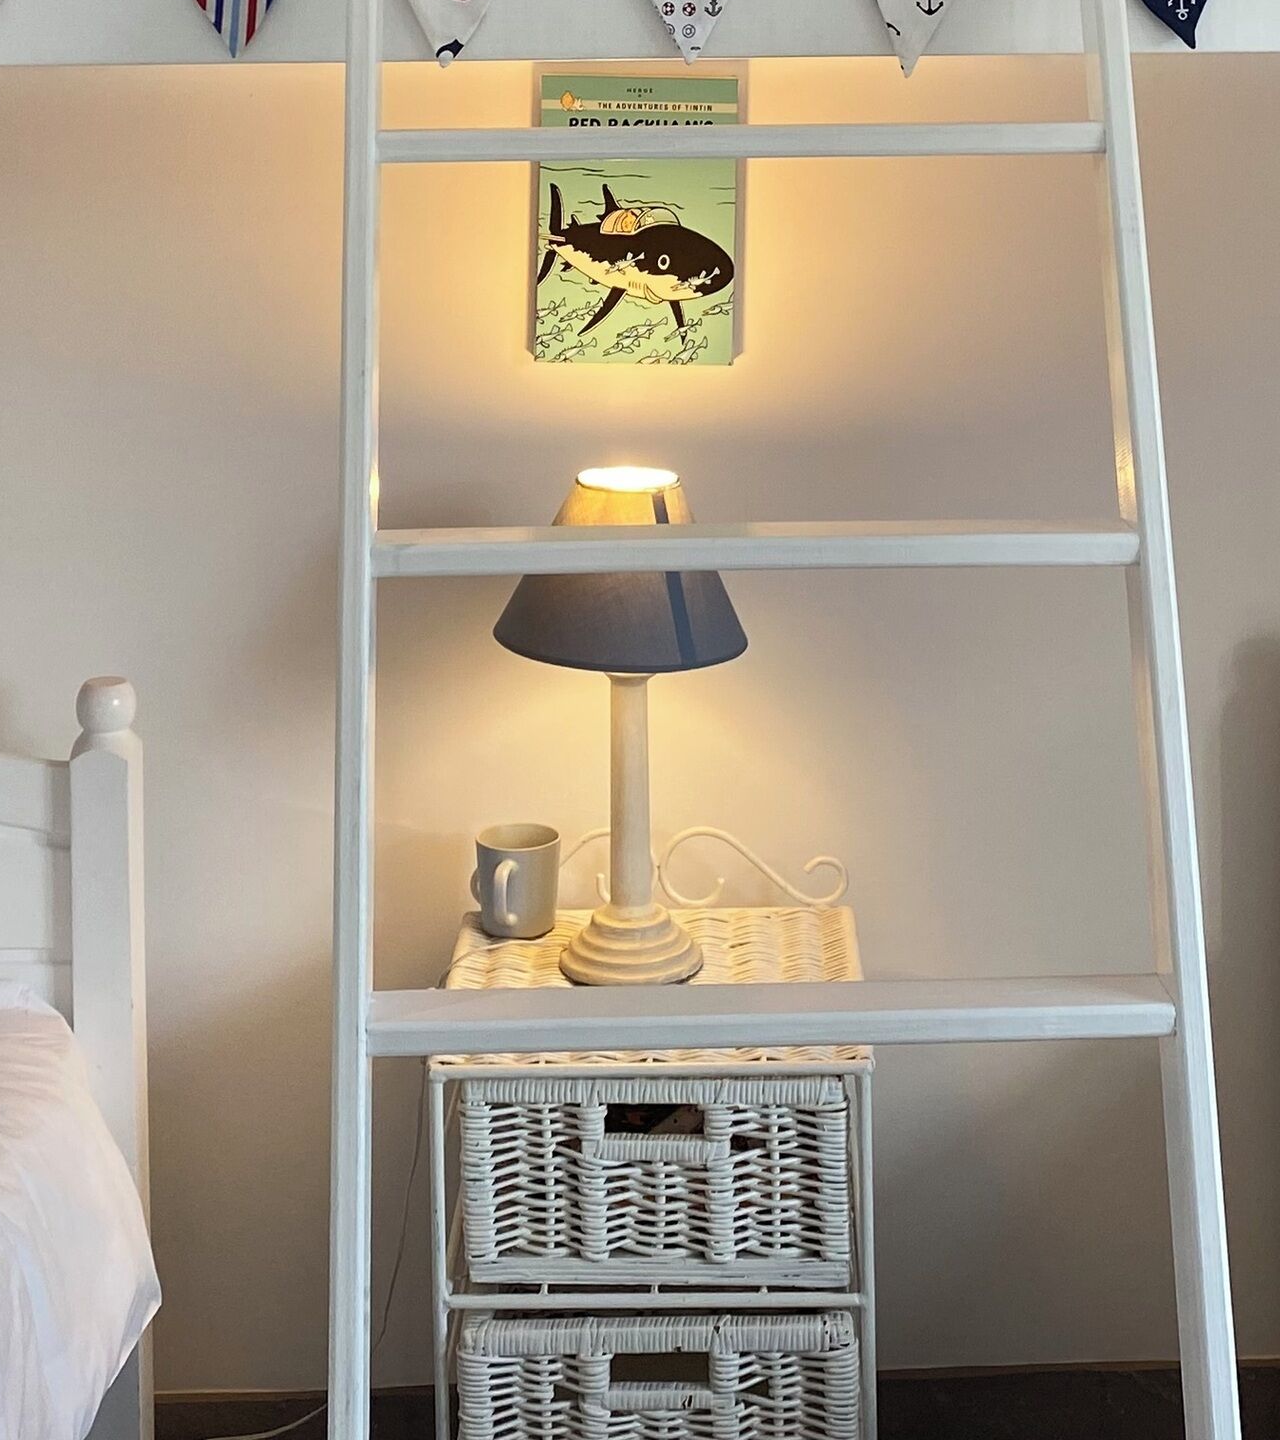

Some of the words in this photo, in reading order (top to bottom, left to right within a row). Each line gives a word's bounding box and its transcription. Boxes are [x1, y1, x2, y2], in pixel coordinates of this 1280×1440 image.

[615, 102, 669, 111] ADVENTURES
[671, 103, 681, 111] OF
[685, 103, 713, 112] TINTIN
